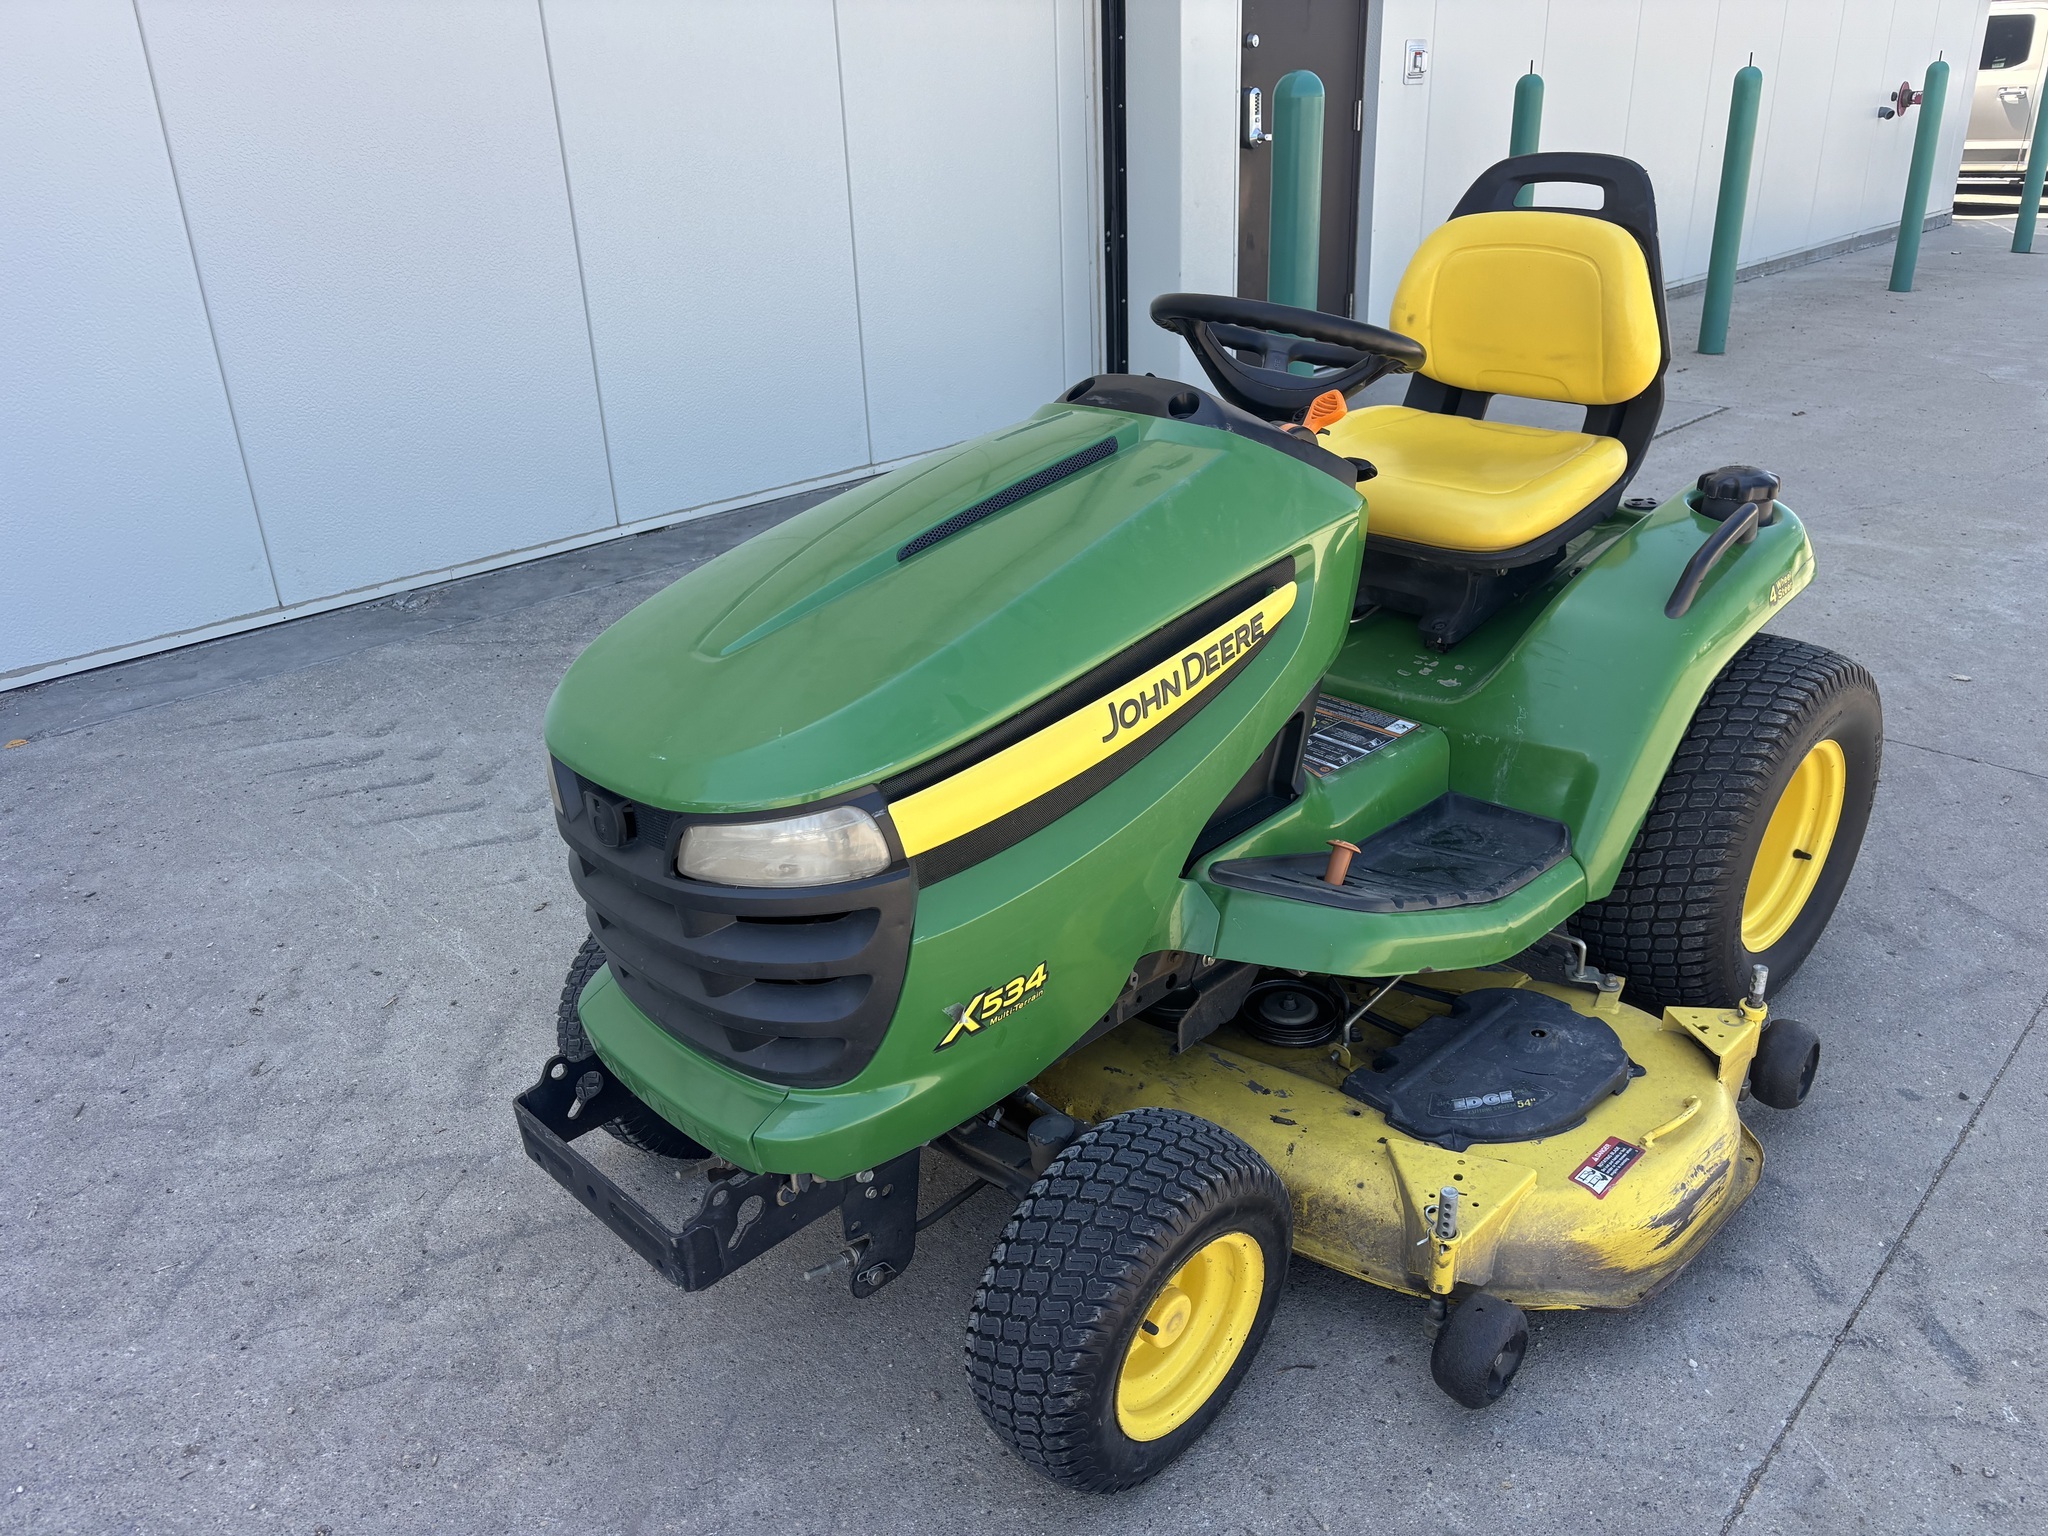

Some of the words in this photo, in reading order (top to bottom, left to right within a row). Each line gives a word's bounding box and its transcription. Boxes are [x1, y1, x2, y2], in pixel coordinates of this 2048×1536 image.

[1769, 585, 1776, 602] 4
[1775, 571, 1792, 589] Wheel
[1102, 669, 1181, 743] JOHN
[1181, 611, 1265, 691] DEERE
[935, 961, 1048, 1050] X534
[989, 989, 1044, 1026] Multi-Terrain
[1451, 1090, 1514, 1111] EDGE
[1516, 1097, 1536, 1109] 54"
[1594, 1144, 1611, 1158] DANGER
